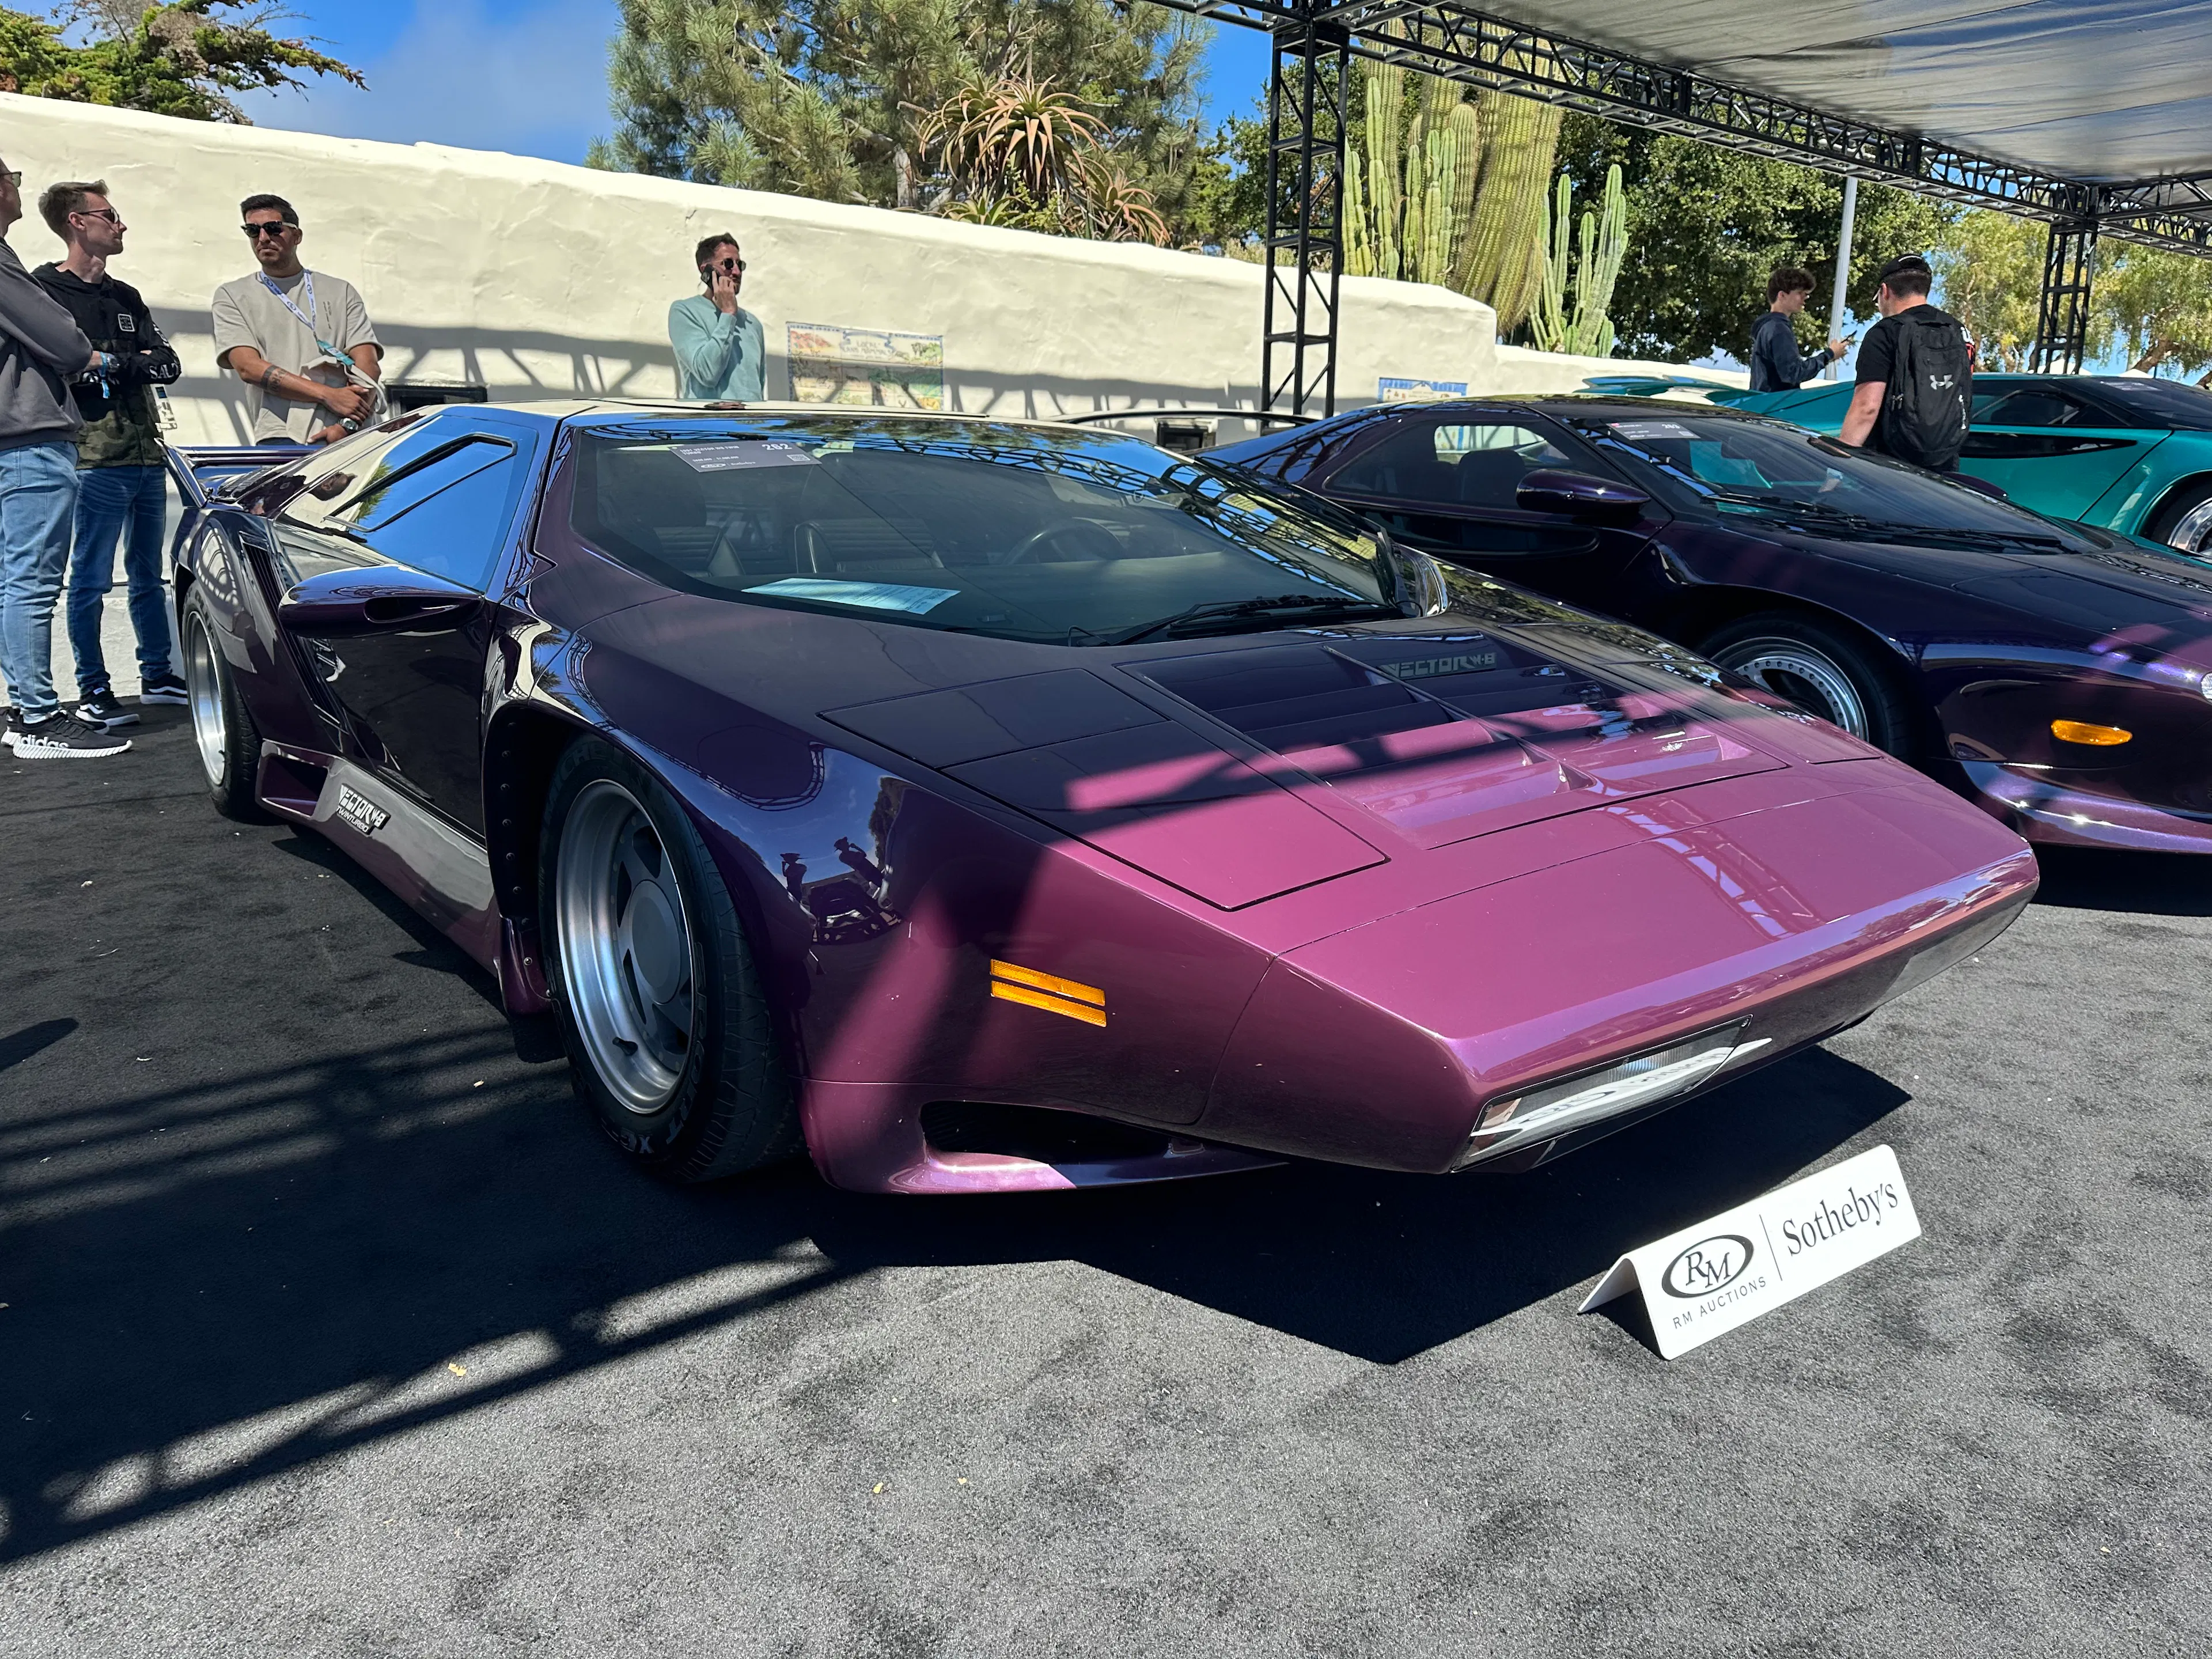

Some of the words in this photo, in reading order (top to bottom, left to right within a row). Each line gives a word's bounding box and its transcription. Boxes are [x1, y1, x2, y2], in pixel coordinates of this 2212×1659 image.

[1381, 656, 1475, 679] VECTOR
[339, 784, 375, 825] VECTOR
[1782, 1183, 1898, 1257] Sotheby's
[1684, 1251, 1732, 1289] RM
[1672, 1310, 1693, 1330] RM
[1700, 1276, 1767, 1317] AUCTIONS
